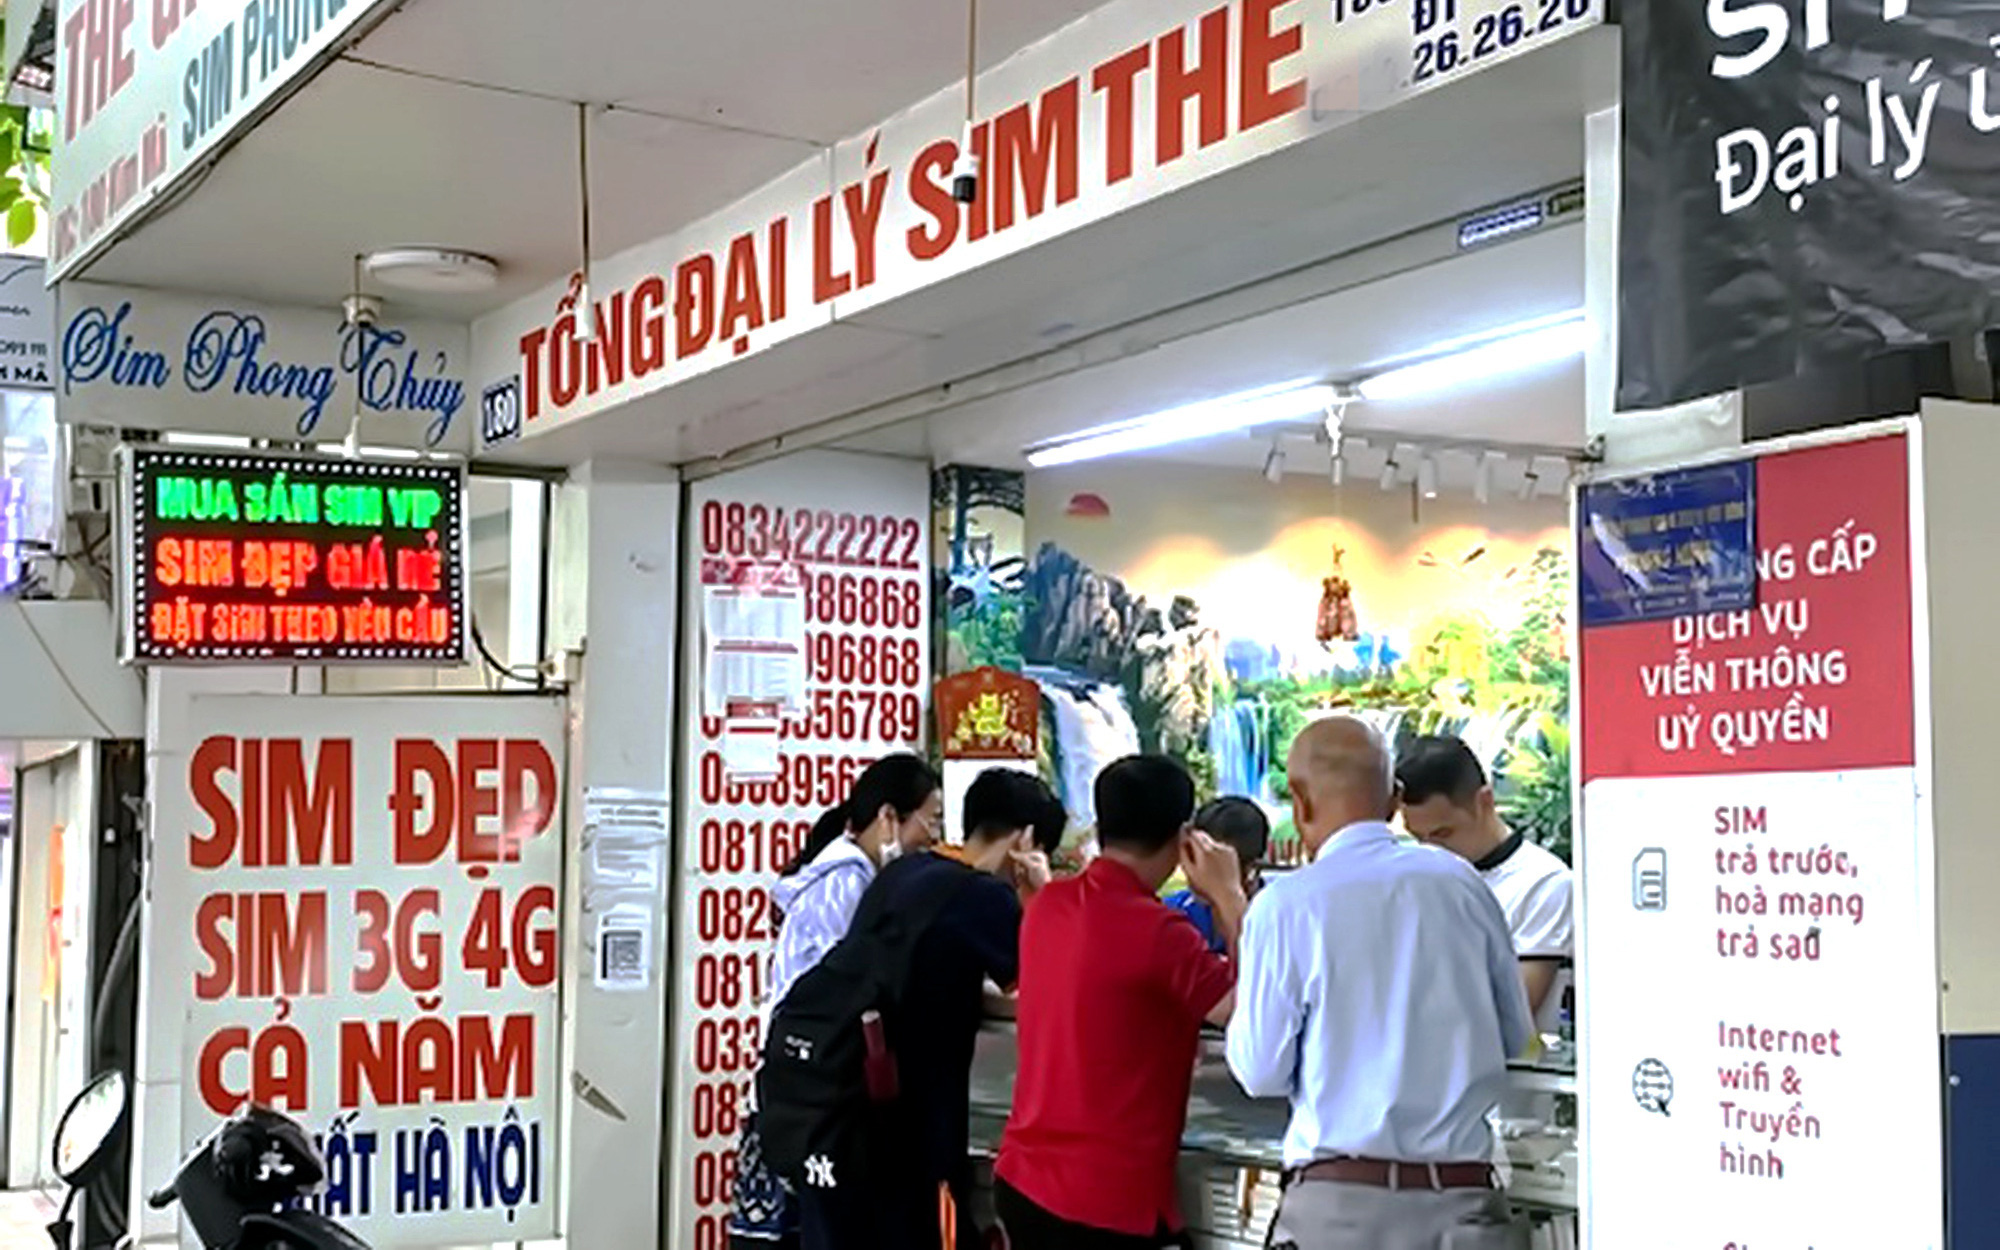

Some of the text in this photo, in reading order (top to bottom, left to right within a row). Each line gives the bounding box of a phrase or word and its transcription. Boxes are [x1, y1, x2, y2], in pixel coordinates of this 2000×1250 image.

[183, 20, 235, 150] SIM
[1716, 94, 1840, 214] Đại
[1867, 58, 1941, 180] lý
[520, 272, 665, 420] TỔNG
[674, 217, 787, 361] ĐẠI
[813, 129, 889, 304] LÝ
[906, 75, 1079, 260] SIM
[63, 302, 466, 447] Sim Phong Thủy
[156, 477, 239, 521] MUA
[324, 485, 383, 525] SIM
[387, 488, 442, 528] VIP
[703, 500, 919, 570] 0834222222
[1807, 518, 1877, 576] CẤP
[156, 538, 234, 586] SIM
[241, 541, 318, 596] ĐẸP
[327, 535, 389, 590] GIÁ
[270, 604, 337, 642] THEO
[1673, 598, 1809, 650] DỊCH VỤ
[1640, 645, 1847, 697] VIỄN THÔNG
[1658, 692, 1829, 755] UỶ QUYỀN
[189, 735, 352, 868] SIM
[388, 738, 557, 880] ĐẸP
[1715, 806, 1767, 835] SIM
[1715, 842, 1858, 878] trả trước,
[1778, 892, 1864, 926] mạng
[194, 886, 557, 1000] SIM 3G 4G
[1717, 924, 1759, 958] trả
[199, 995, 534, 1117] CẢ NĂM
[1719, 1020, 1841, 1056] Internet
[1718, 1060, 1802, 1095] wifi &
[1719, 1101, 1820, 1143] Truyền
[397, 1118, 450, 1214] HÀ
[464, 1106, 539, 1222] NỘI
[1719, 1141, 1784, 1180] hình
